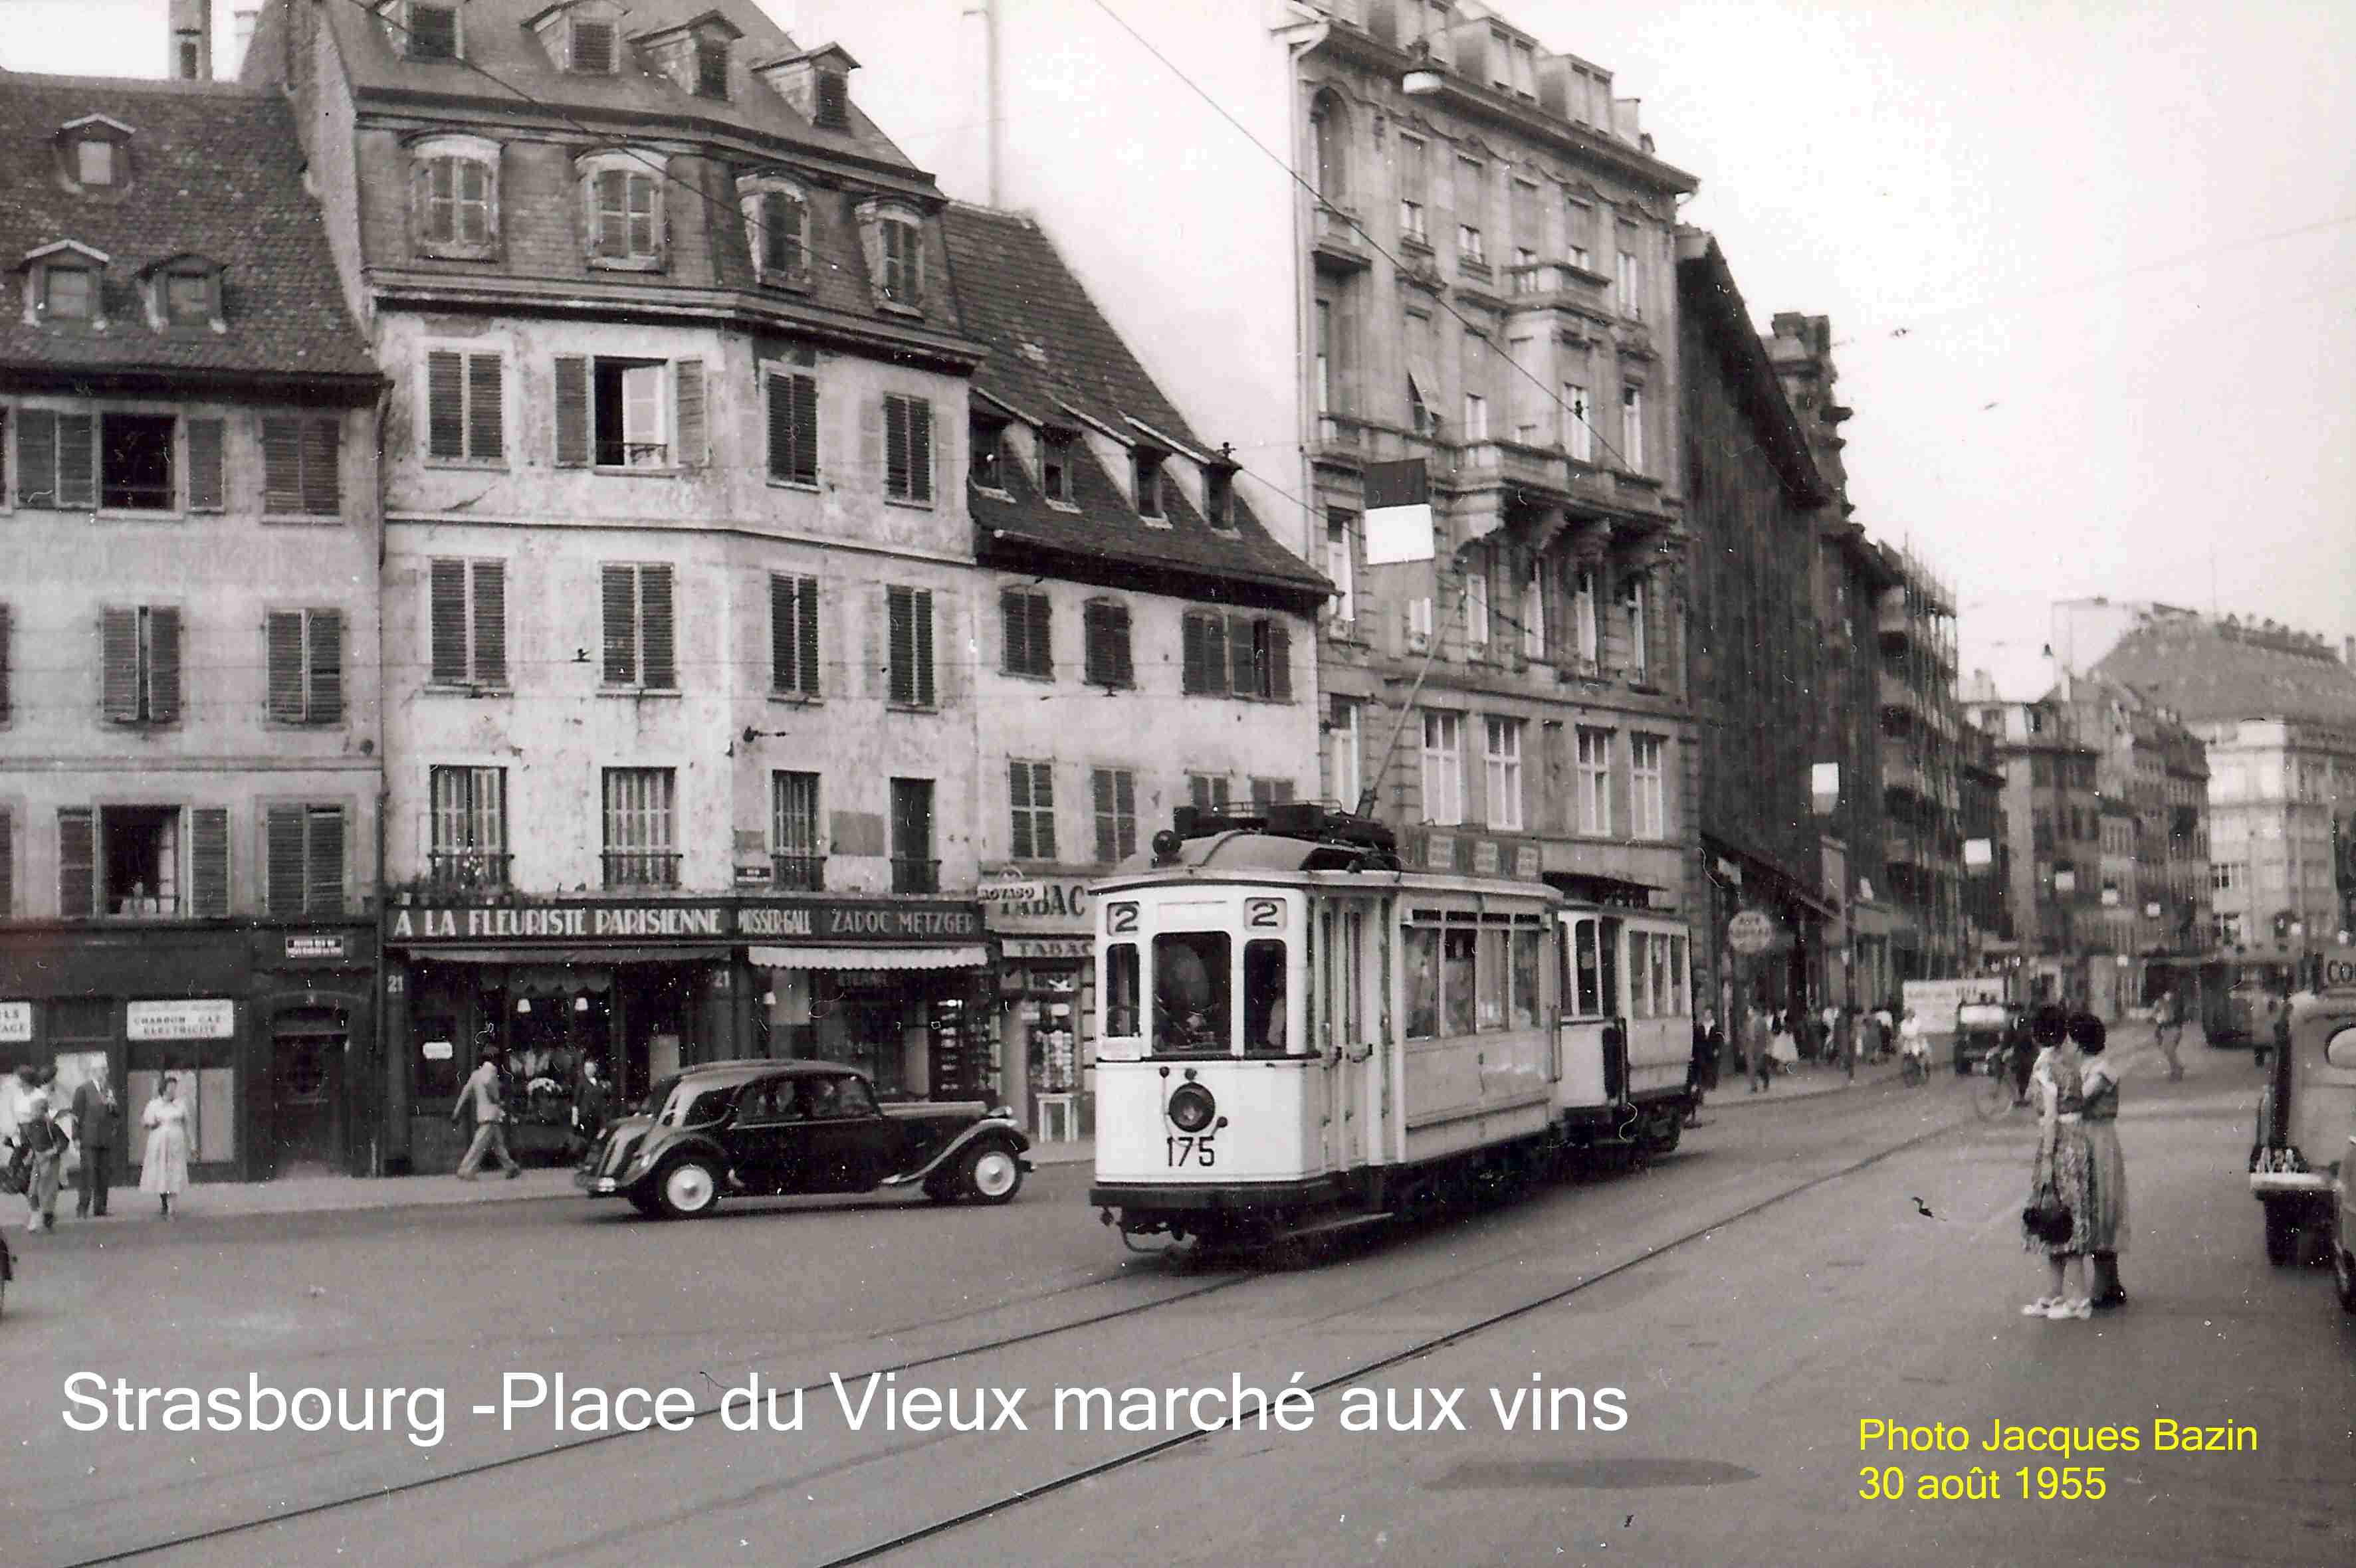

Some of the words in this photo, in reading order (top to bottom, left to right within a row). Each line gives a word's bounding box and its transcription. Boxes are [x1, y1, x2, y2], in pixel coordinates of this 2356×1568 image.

[395, 910, 413, 936] A
[425, 910, 457, 937] LA
[469, 909, 587, 936] FLEURISTE
[595, 908, 722, 935] PARISIENNE
[898, 912, 974, 935] METZGER
[1115, 906, 1138, 931] 2
[1251, 902, 1278, 927] 2
[1017, 941, 1093, 957] TABAC
[388, 975, 403, 993] 21
[2327, 959, 2356, 984] CO
[1167, 1135, 1214, 1167] 175
